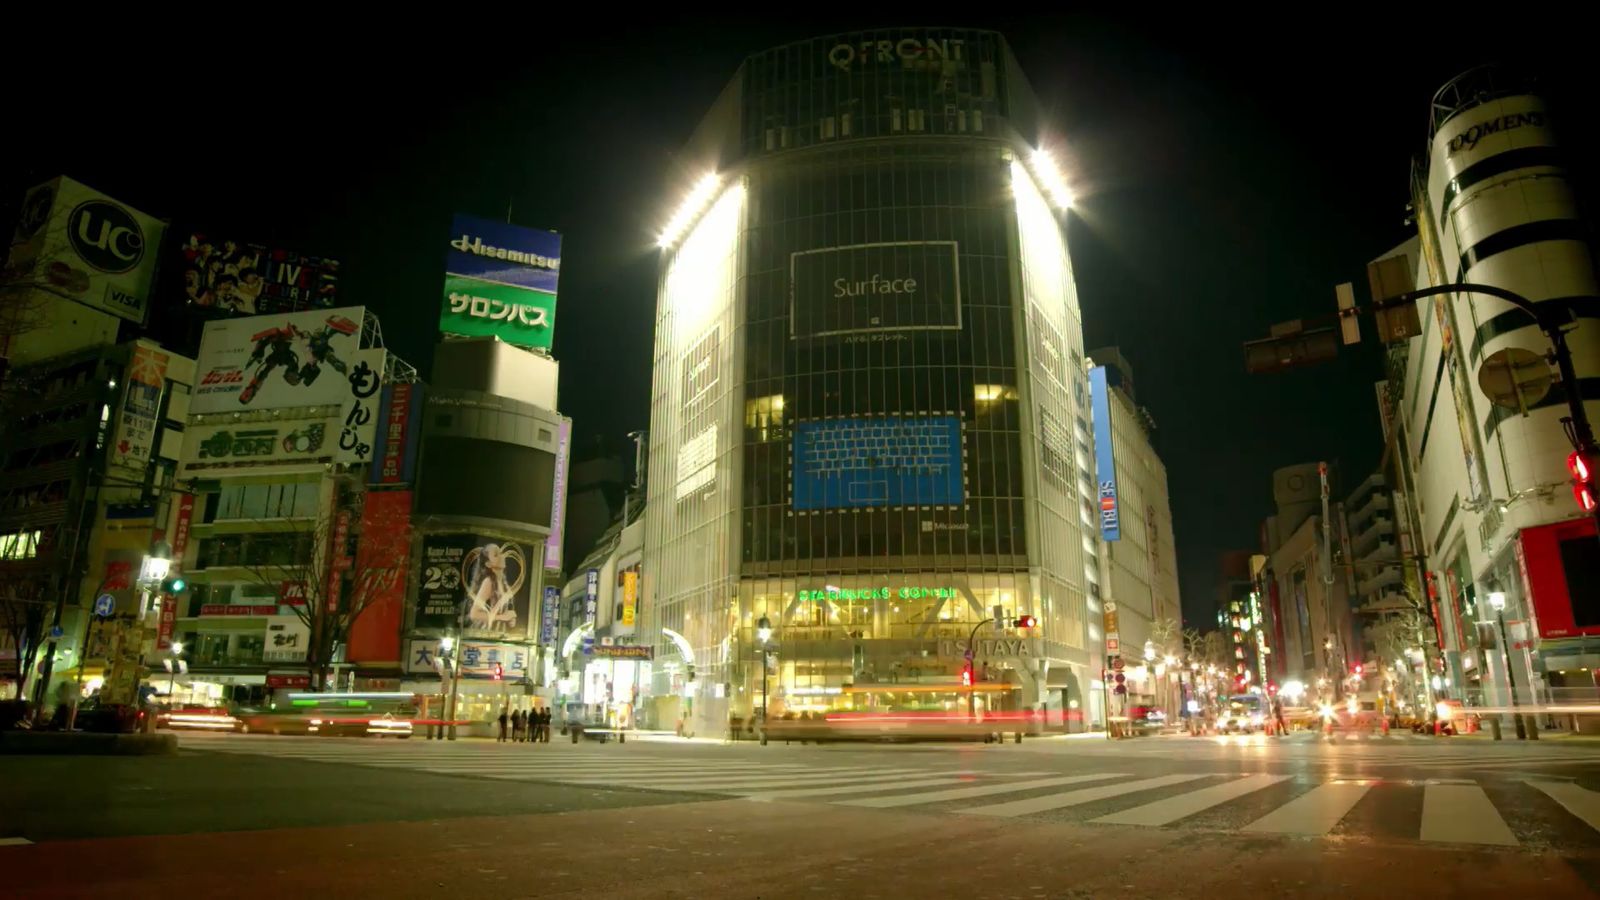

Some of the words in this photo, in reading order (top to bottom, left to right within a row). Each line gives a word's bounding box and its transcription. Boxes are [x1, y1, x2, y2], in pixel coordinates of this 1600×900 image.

[828, 37, 965, 71] QFRONT
[111, 290, 142, 310] VISA
[833, 273, 917, 298] Surface
[448, 291, 549, 328] サロンパス
[340, 360, 380, 460] もんじゃ
[1101, 480, 1118, 529] SEIBU
[799, 586, 891, 601] STARBUCKS
